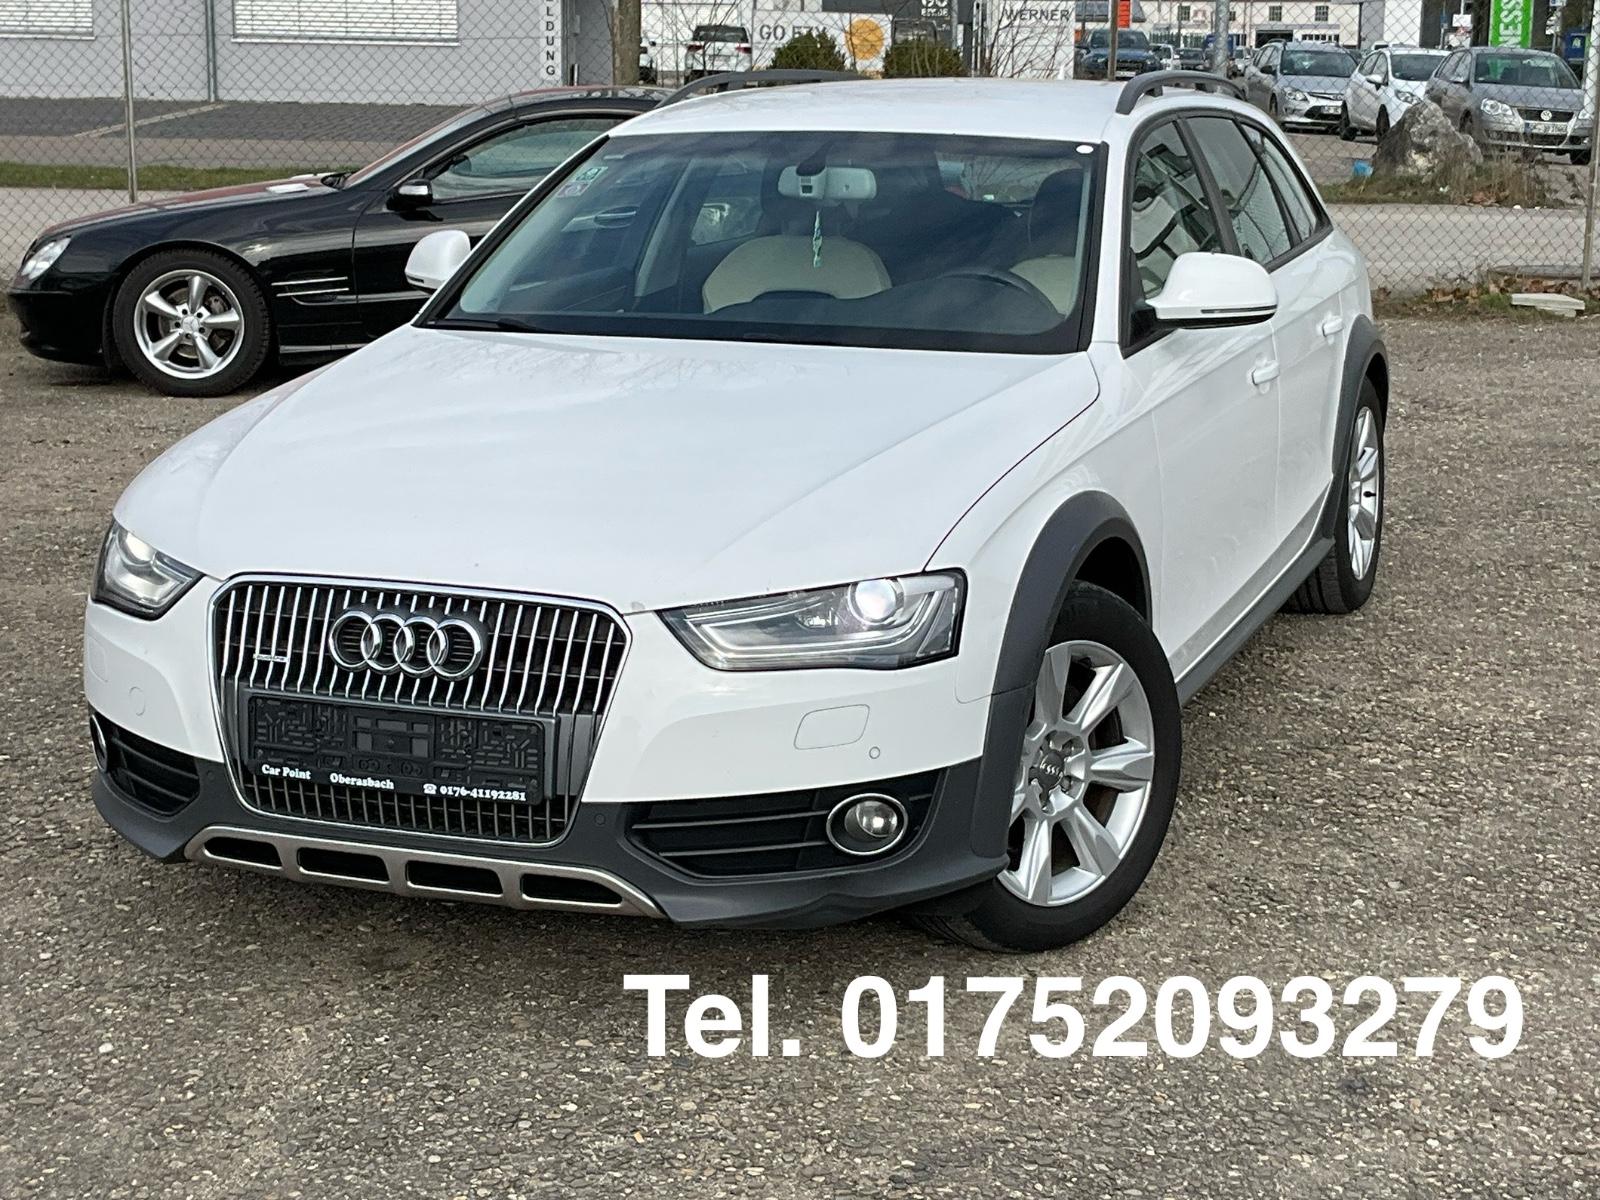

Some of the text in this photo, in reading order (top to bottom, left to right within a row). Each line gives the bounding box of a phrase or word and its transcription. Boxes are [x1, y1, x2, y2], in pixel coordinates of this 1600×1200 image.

[1004, 8, 1070, 22] WERNER
[545, 0, 556, 76] LDUNG
[759, 24, 786, 41] GO
[261, 763, 527, 802] Car Point Oberasbach 0176-41192281
